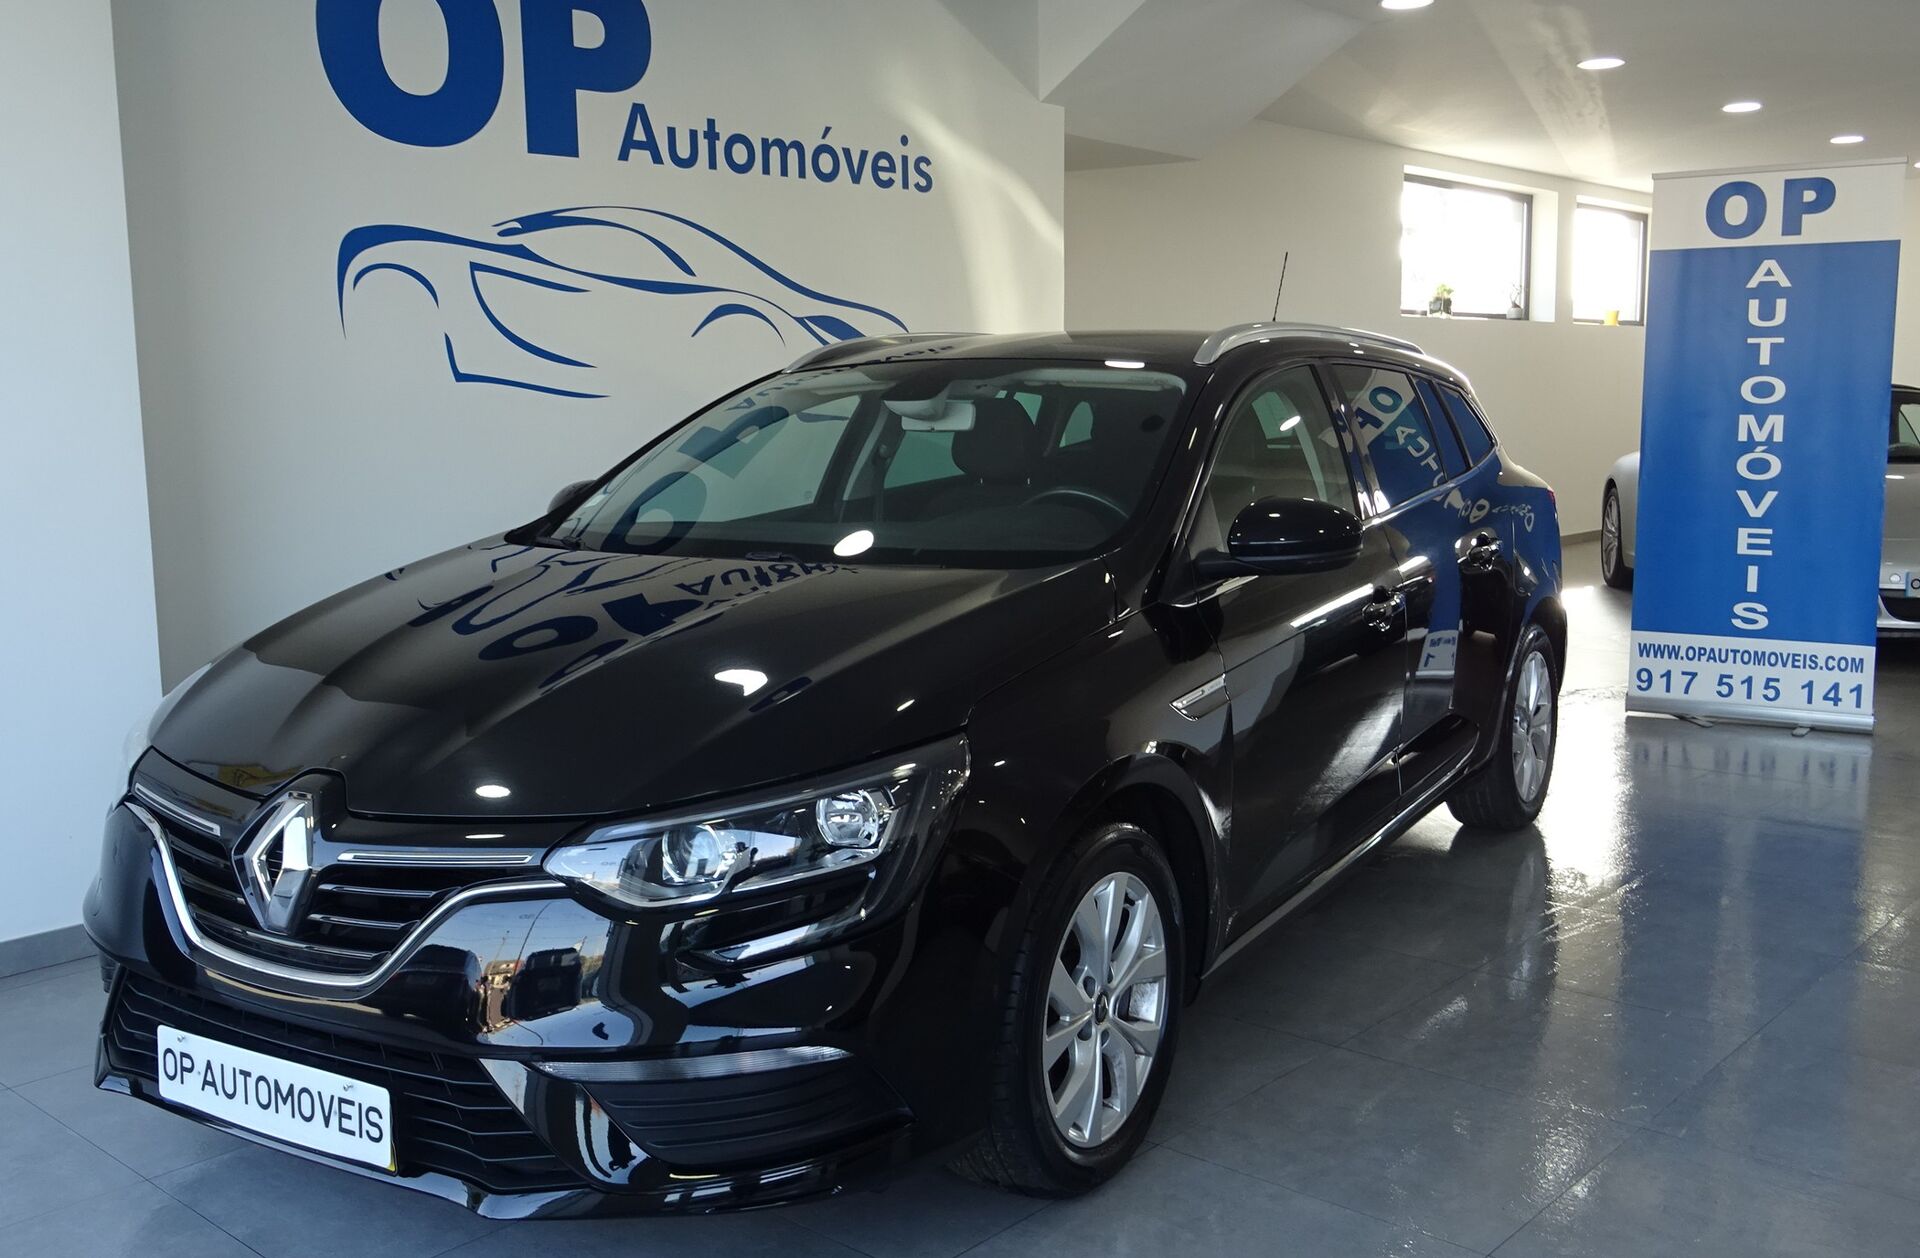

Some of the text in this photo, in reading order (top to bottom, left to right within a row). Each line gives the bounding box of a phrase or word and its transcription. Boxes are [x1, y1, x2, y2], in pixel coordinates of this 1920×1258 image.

[315, 0, 651, 158] OP
[617, 102, 933, 193] Automóveis
[1705, 177, 1837, 239] OP
[1731, 259, 1792, 631] AUTOMÓVEIS
[1635, 667, 1863, 709] 917 515 141
[1637, 642, 1864, 674] WWW.OPAUTOMOVEIS.COM
[163, 1047, 384, 1143] OP AUTOMOVEIS
